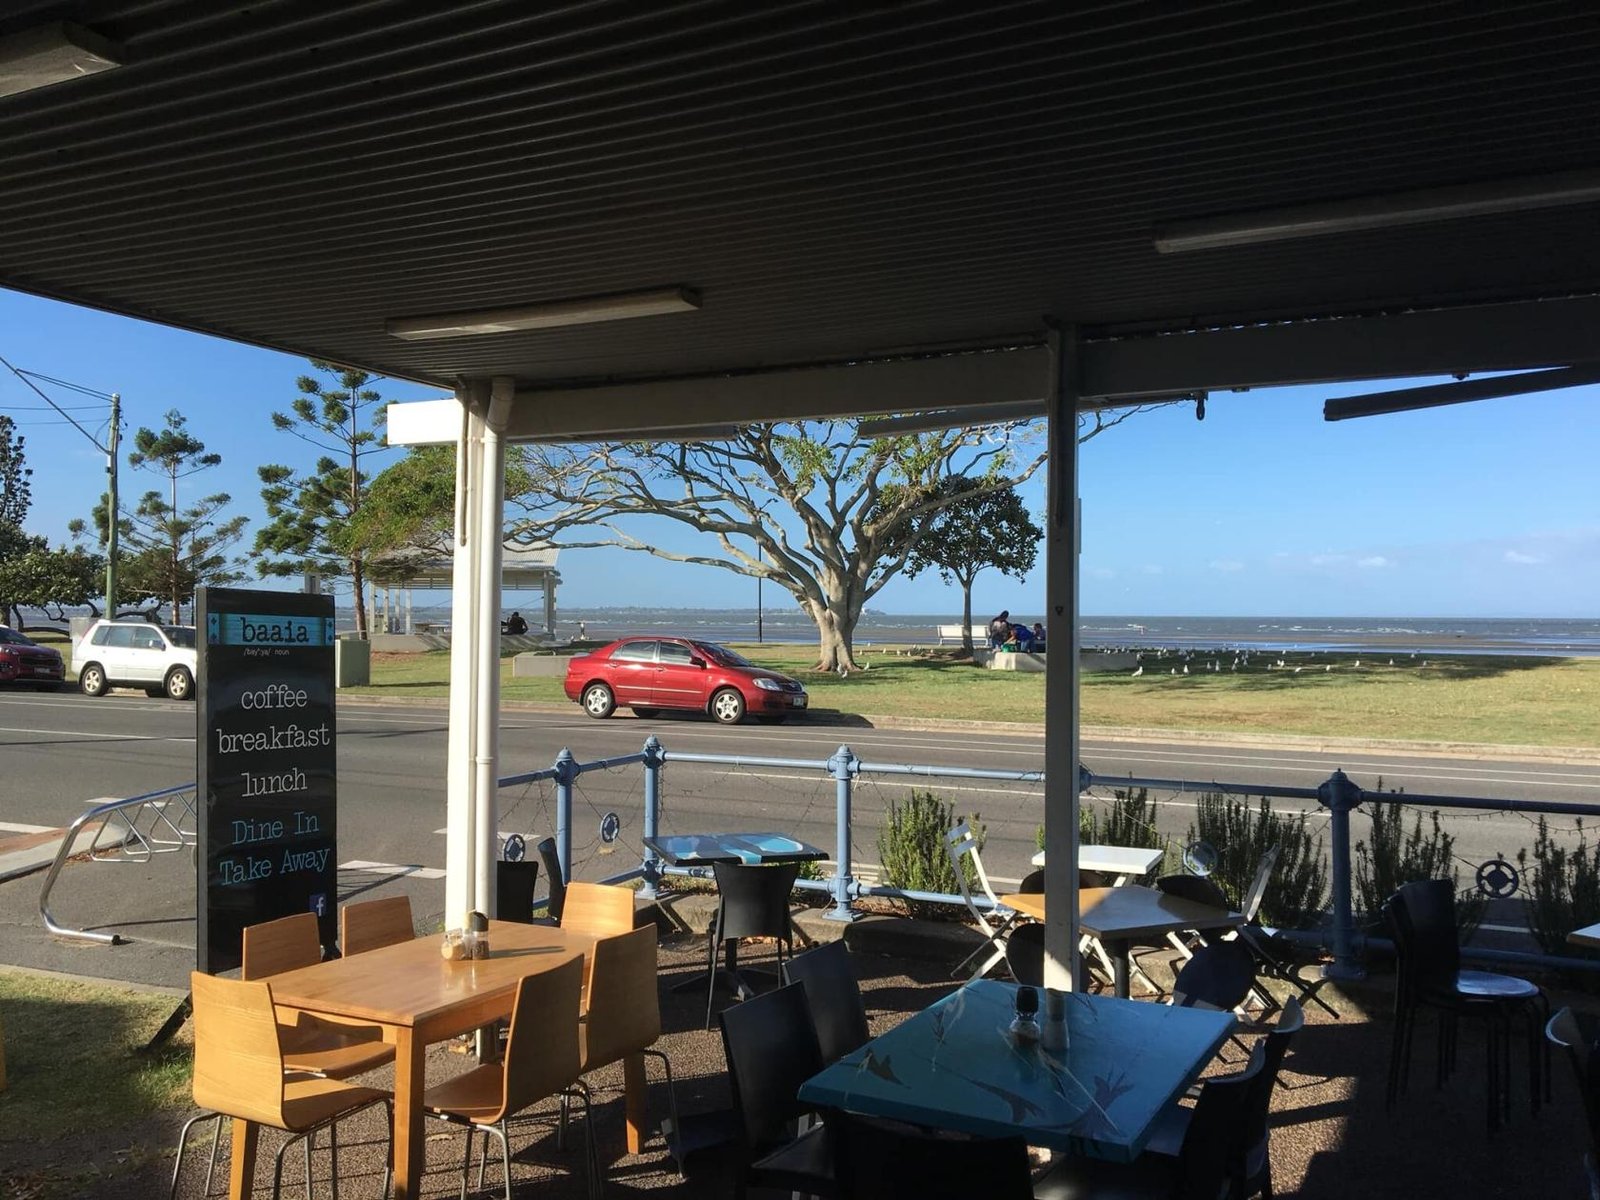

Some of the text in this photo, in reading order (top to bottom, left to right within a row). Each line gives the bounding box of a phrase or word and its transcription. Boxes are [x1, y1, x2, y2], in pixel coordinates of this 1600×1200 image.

[240, 617, 309, 643] baaia
[241, 684, 307, 710] coffee
[216, 723, 330, 754] breakfast
[241, 767, 308, 798] lunch
[232, 811, 319, 845] Dine In
[219, 847, 331, 886] Take Away
